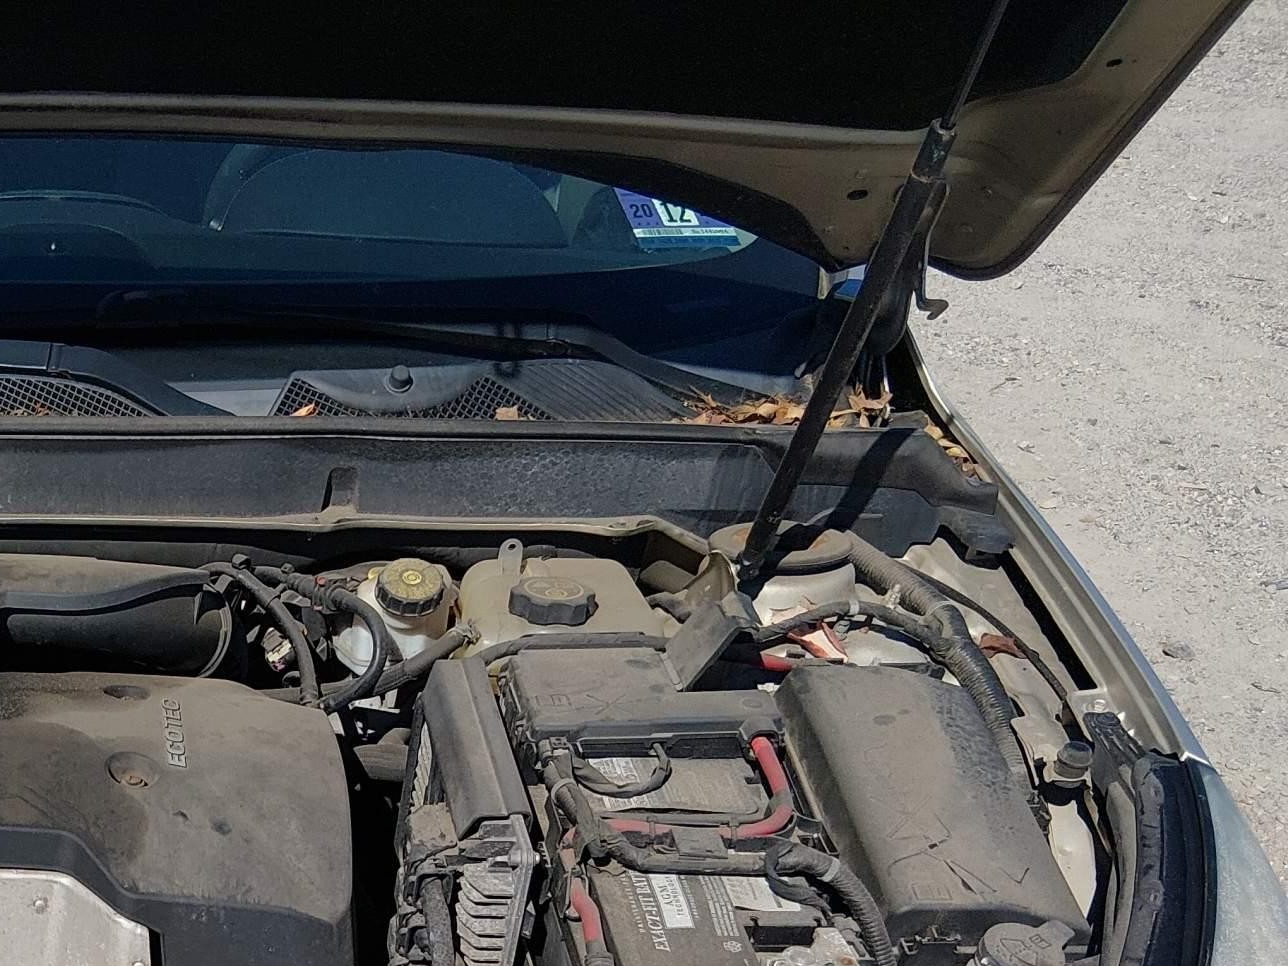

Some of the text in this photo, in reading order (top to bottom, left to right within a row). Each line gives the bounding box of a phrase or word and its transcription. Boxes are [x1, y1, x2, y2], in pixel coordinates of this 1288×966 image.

[630, 202, 692, 223] 20 12
[162, 697, 188, 769] ECOTEC
[657, 884, 674, 906] AGM
[638, 894, 672, 953] EXACT-FIT
